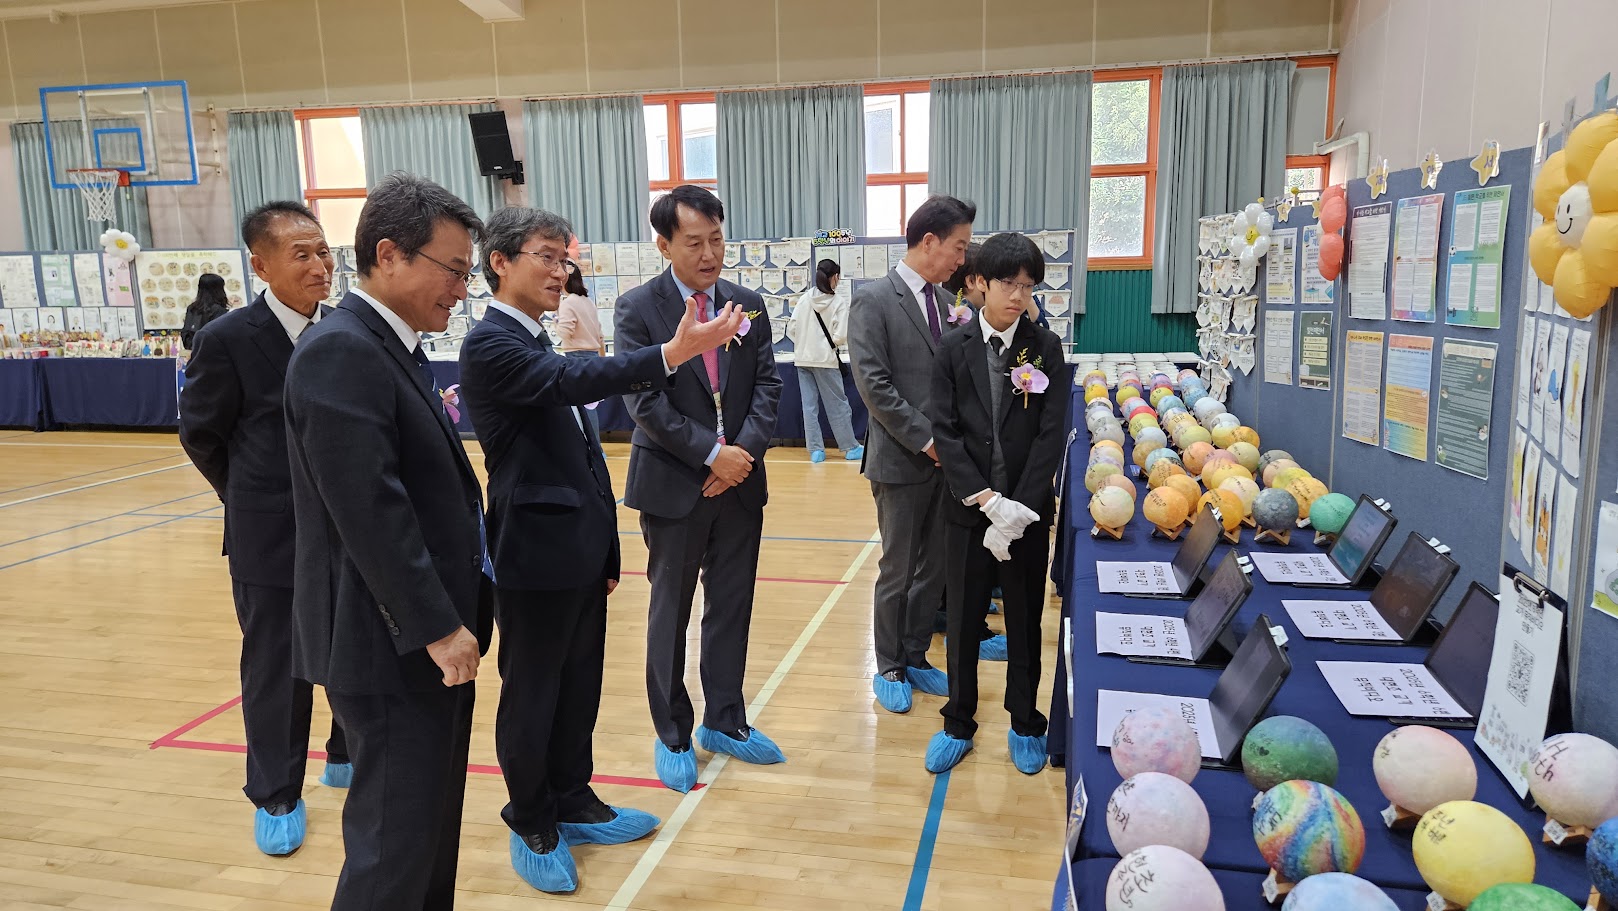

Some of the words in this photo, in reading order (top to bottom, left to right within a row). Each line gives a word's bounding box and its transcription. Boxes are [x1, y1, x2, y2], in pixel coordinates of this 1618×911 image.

[1484, 155, 1494, 169] 서
[1352, 677, 1384, 702] 뮤직비디오
[1399, 668, 1427, 688] 2025년
[1416, 690, 1441, 705] 6학년
[1393, 694, 1414, 705] 교가
